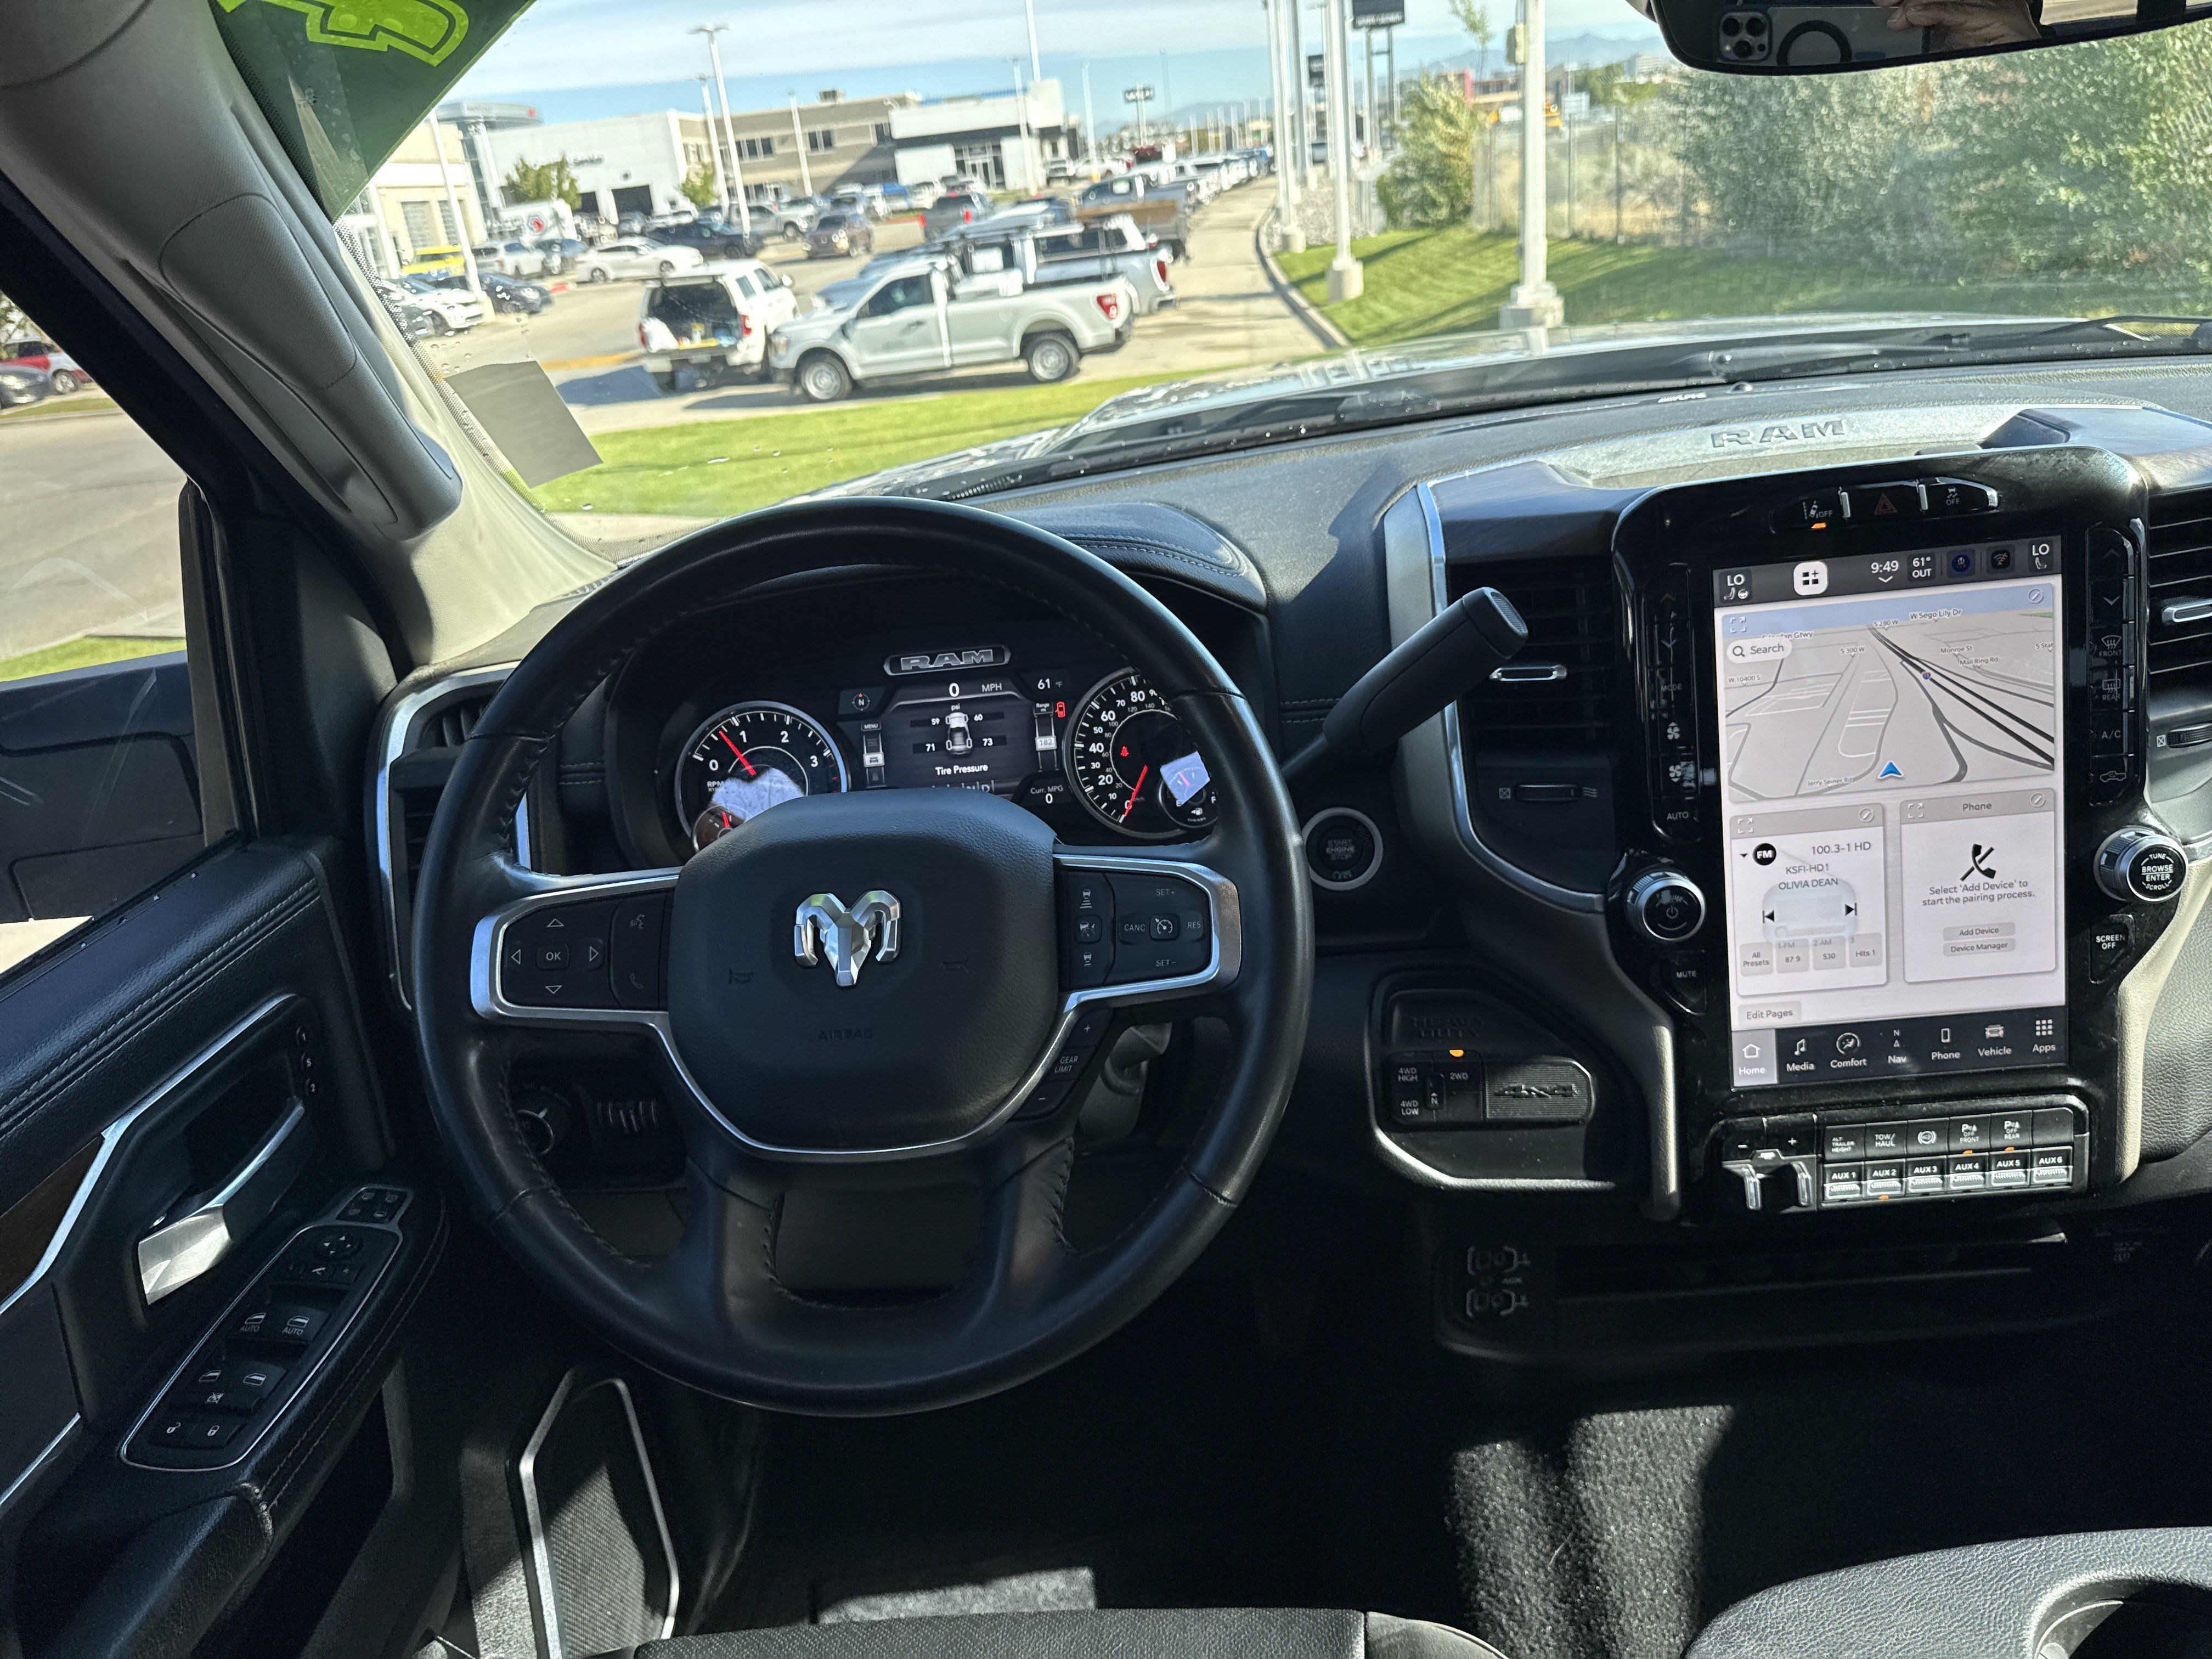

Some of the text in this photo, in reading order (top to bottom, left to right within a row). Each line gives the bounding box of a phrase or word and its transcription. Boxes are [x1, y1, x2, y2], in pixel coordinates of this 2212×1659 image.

[1711, 419, 1848, 448] RAM
[2032, 544, 2050, 556] LO
[1871, 560, 1899, 573] 9:49
[1912, 556, 1931, 567] 61°
[1912, 568, 1932, 578] OUT
[1727, 574, 1745, 586] LO
[1751, 643, 1784, 654] Search
[901, 649, 994, 671] RAM
[949, 682, 1002, 697] 0 MPH
[1037, 678, 1050, 690] 61
[1130, 690, 1145, 702] 80
[951, 703, 960, 712] psi
[931, 713, 983, 725] 59 60
[1101, 710, 1115, 721] 60
[740, 731, 747, 743] 1
[780, 731, 789, 743] 2
[2101, 729, 2121, 739] A/C
[926, 738, 993, 752] 71 73
[1089, 742, 1104, 753] 40
[709, 759, 719, 771] 0
[810, 755, 819, 767] 3
[935, 764, 988, 776] Tire Pressure
[1098, 774, 1113, 785] 20
[1045, 793, 1053, 804] 0
[1211, 795, 1216, 804] F
[1962, 803, 1992, 811] Phone
[1666, 811, 1689, 820] AUTO
[1812, 842, 1871, 855] 100.3-1 HD
[1757, 850, 1772, 859] FM
[1786, 864, 1829, 874] KSFI-HD1
[2141, 864, 2173, 873] BROWSE
[1779, 878, 1838, 890] OLIVIA DEAN
[1929, 886, 1957, 895] Select
[2019, 879, 2028, 888] to
[2145, 882, 2170, 890] SCROLL
[1922, 890, 2035, 906] start the pairing process.
[2096, 934, 2125, 943] SCREEN
[1976, 943, 2008, 951] Manager
[546, 952, 561, 961] OK
[1746, 1009, 1793, 1019] Edit Pages
[1978, 1046, 2012, 1057] Vehicle
[2033, 1044, 2056, 1054] Apps
[1060, 1056, 1079, 1064] GEAR
[1888, 1055, 1906, 1064] Nav
[1931, 1051, 1961, 1060] Phone
[1786, 1062, 1815, 1072] Media
[1830, 1058, 1867, 1069] Comfort
[1054, 1065, 1073, 1074] LIMIT
[1739, 1066, 1765, 1075] Home
[1450, 1072, 1469, 1080] 2WD
[1402, 1108, 1419, 1116] LOW
[1875, 1132, 1895, 1141] TOW/
[281, 1327, 303, 1335] AUTO
